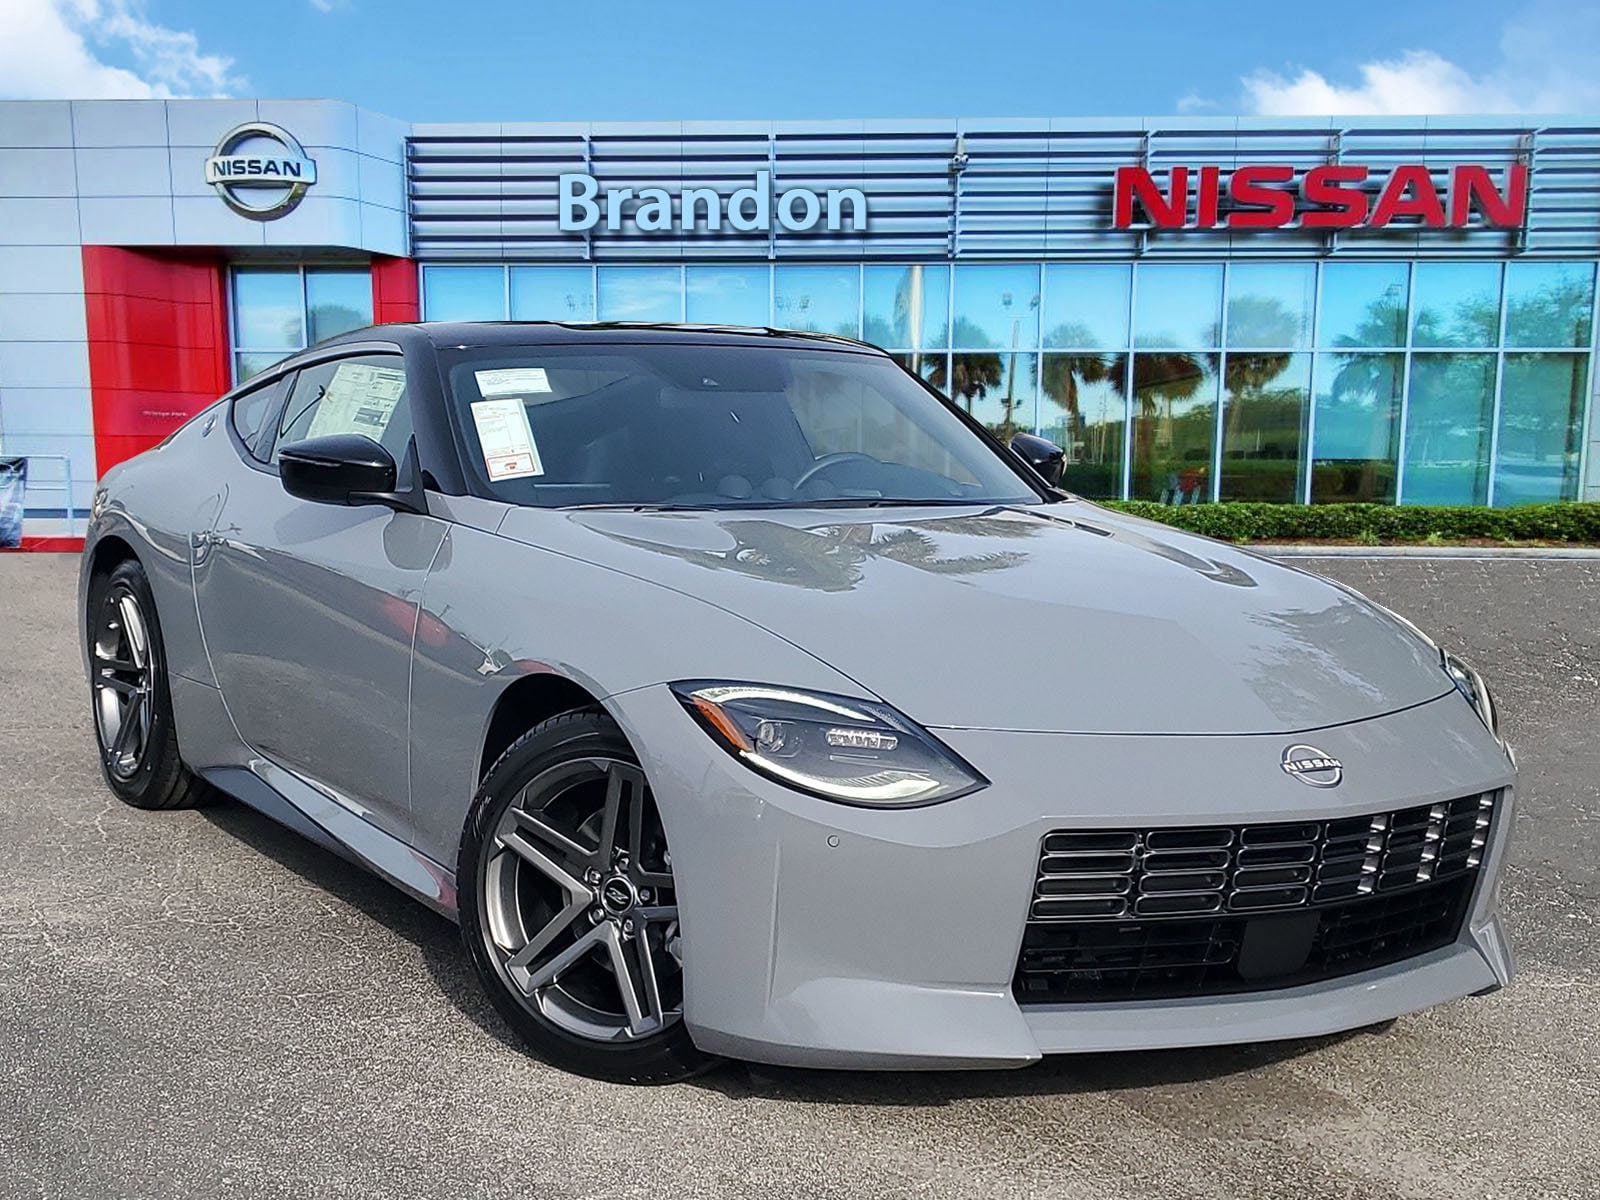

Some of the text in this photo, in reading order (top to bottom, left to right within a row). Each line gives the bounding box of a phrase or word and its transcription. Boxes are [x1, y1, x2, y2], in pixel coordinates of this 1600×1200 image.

[213, 160, 301, 177] NISSAN
[559, 170, 867, 231] Brandon
[1114, 165, 1528, 228] NISSAN
[1283, 759, 1342, 772] NISSAN
